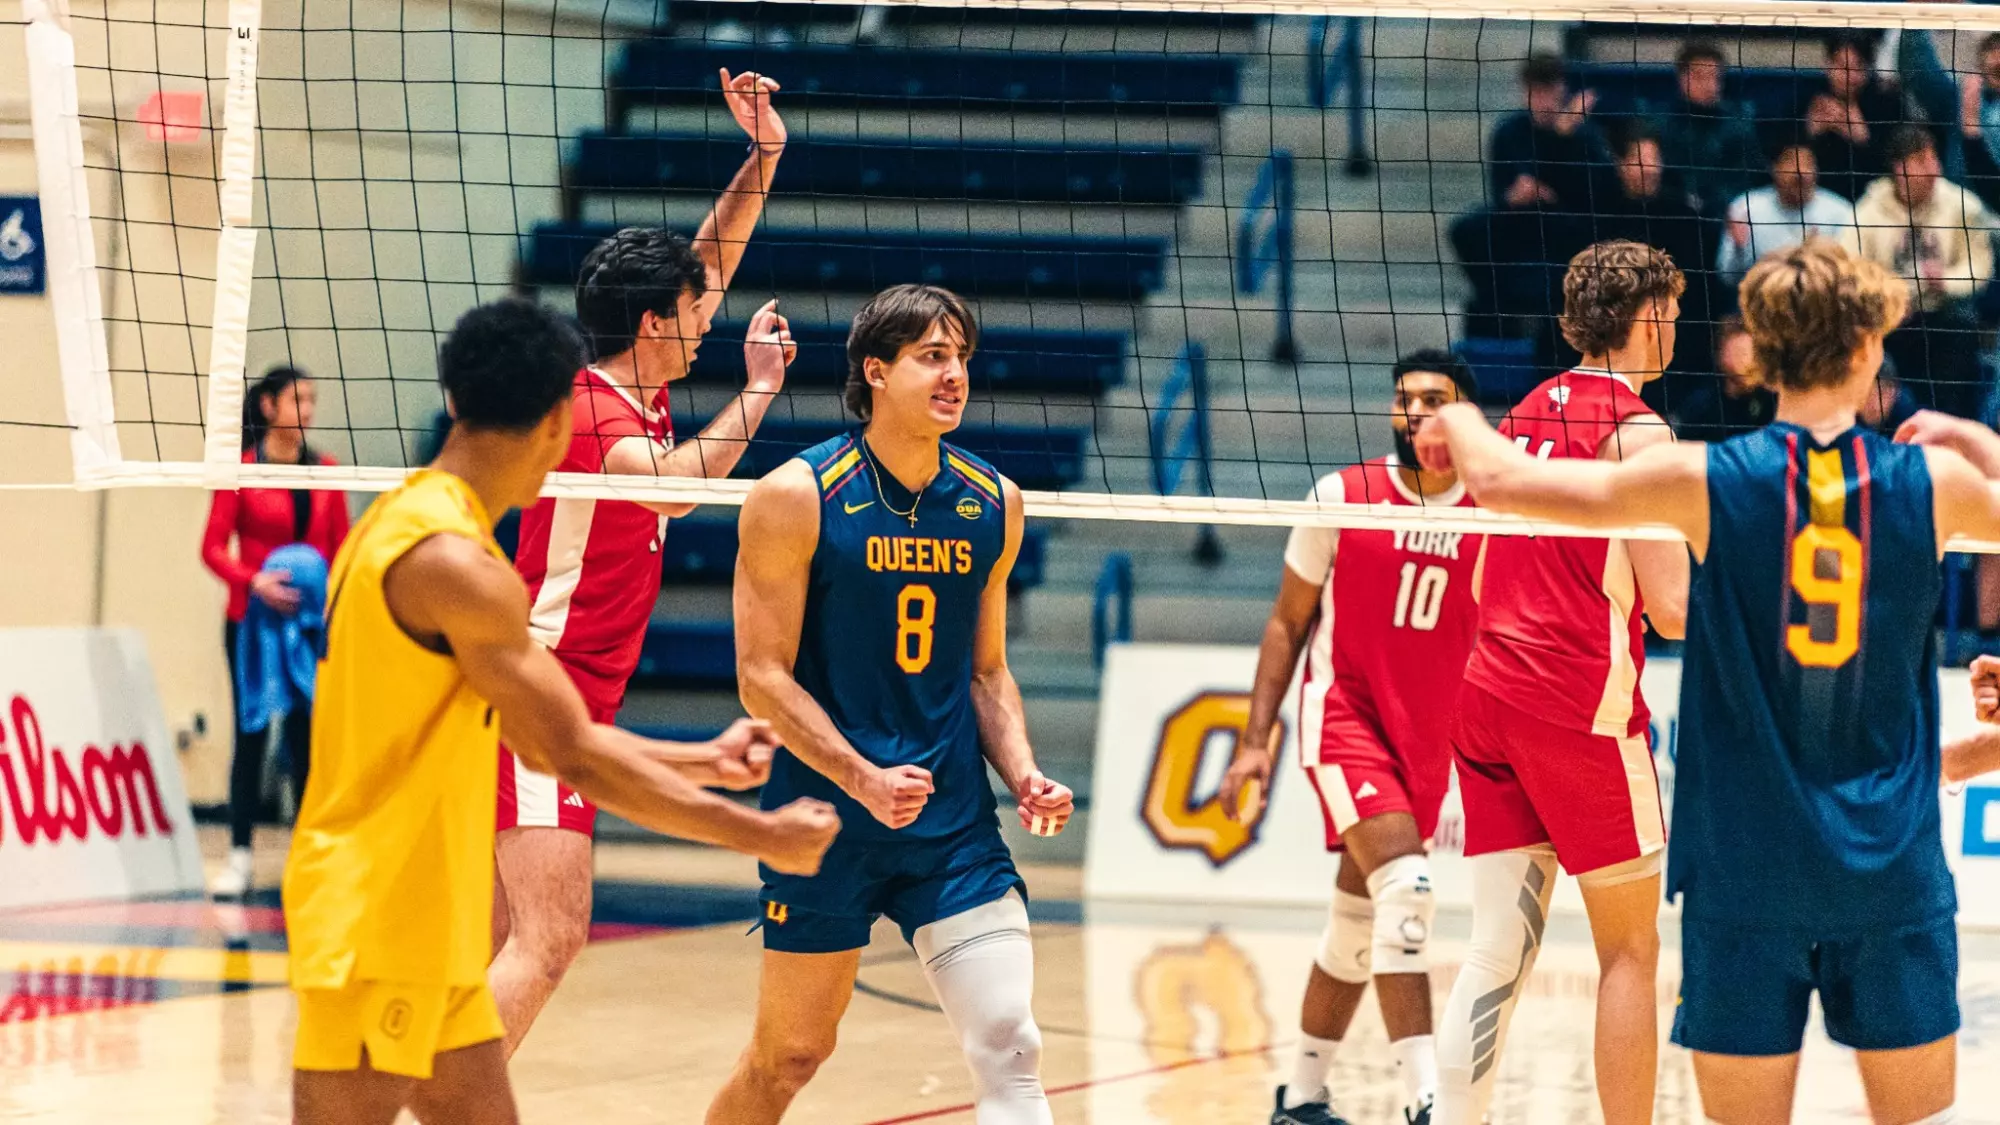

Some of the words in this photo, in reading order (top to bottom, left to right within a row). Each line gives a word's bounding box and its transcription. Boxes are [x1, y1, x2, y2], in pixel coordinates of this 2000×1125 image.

[866, 536, 972, 574] QUEEN'S
[1393, 530, 1463, 560] YORK
[895, 584, 937, 674] 8
[1392, 561, 1449, 630] 10
[1786, 524, 1862, 669] 9
[0, 693, 173, 846] ilson
